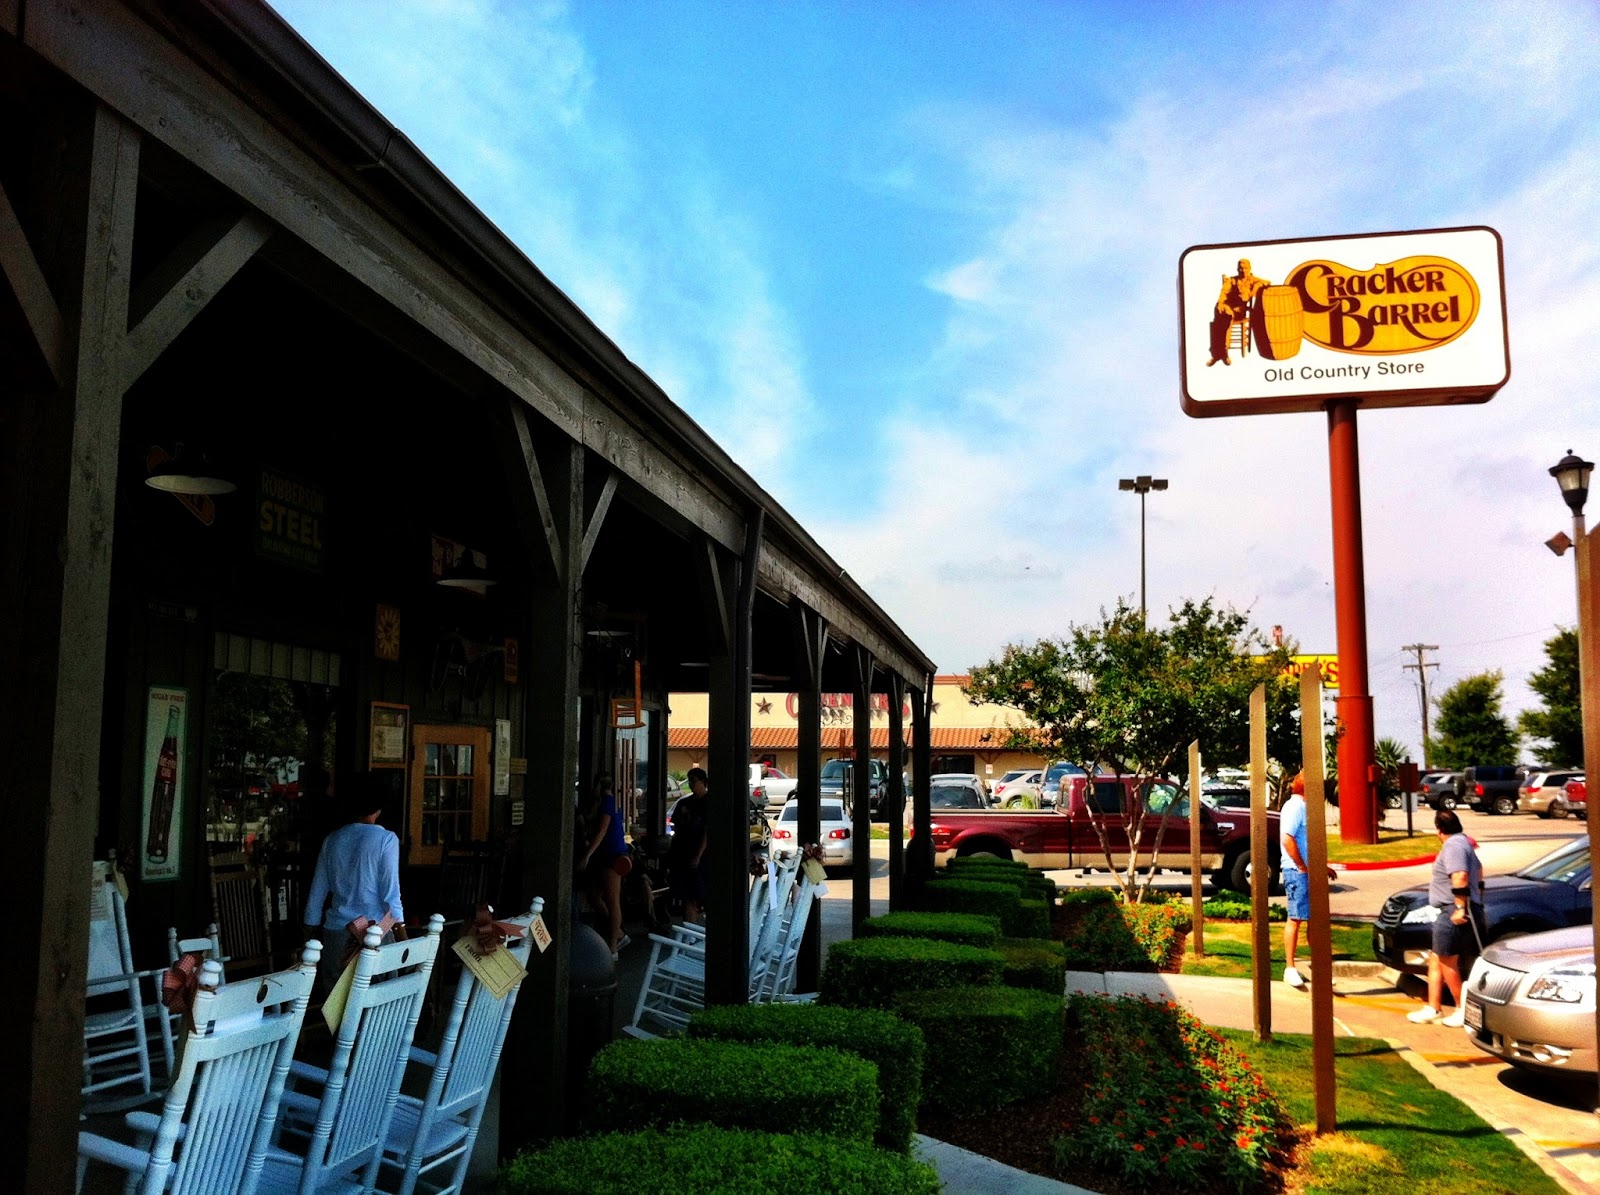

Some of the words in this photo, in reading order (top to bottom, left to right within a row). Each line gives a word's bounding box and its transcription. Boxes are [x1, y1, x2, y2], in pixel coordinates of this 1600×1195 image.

[1290, 264, 1446, 312] Cracker
[1329, 294, 1460, 349] Barrel
[1264, 367, 1294, 382] Old
[1300, 363, 1371, 380] Country
[1378, 361, 1425, 376] Store
[260, 499, 322, 551] STEEL
